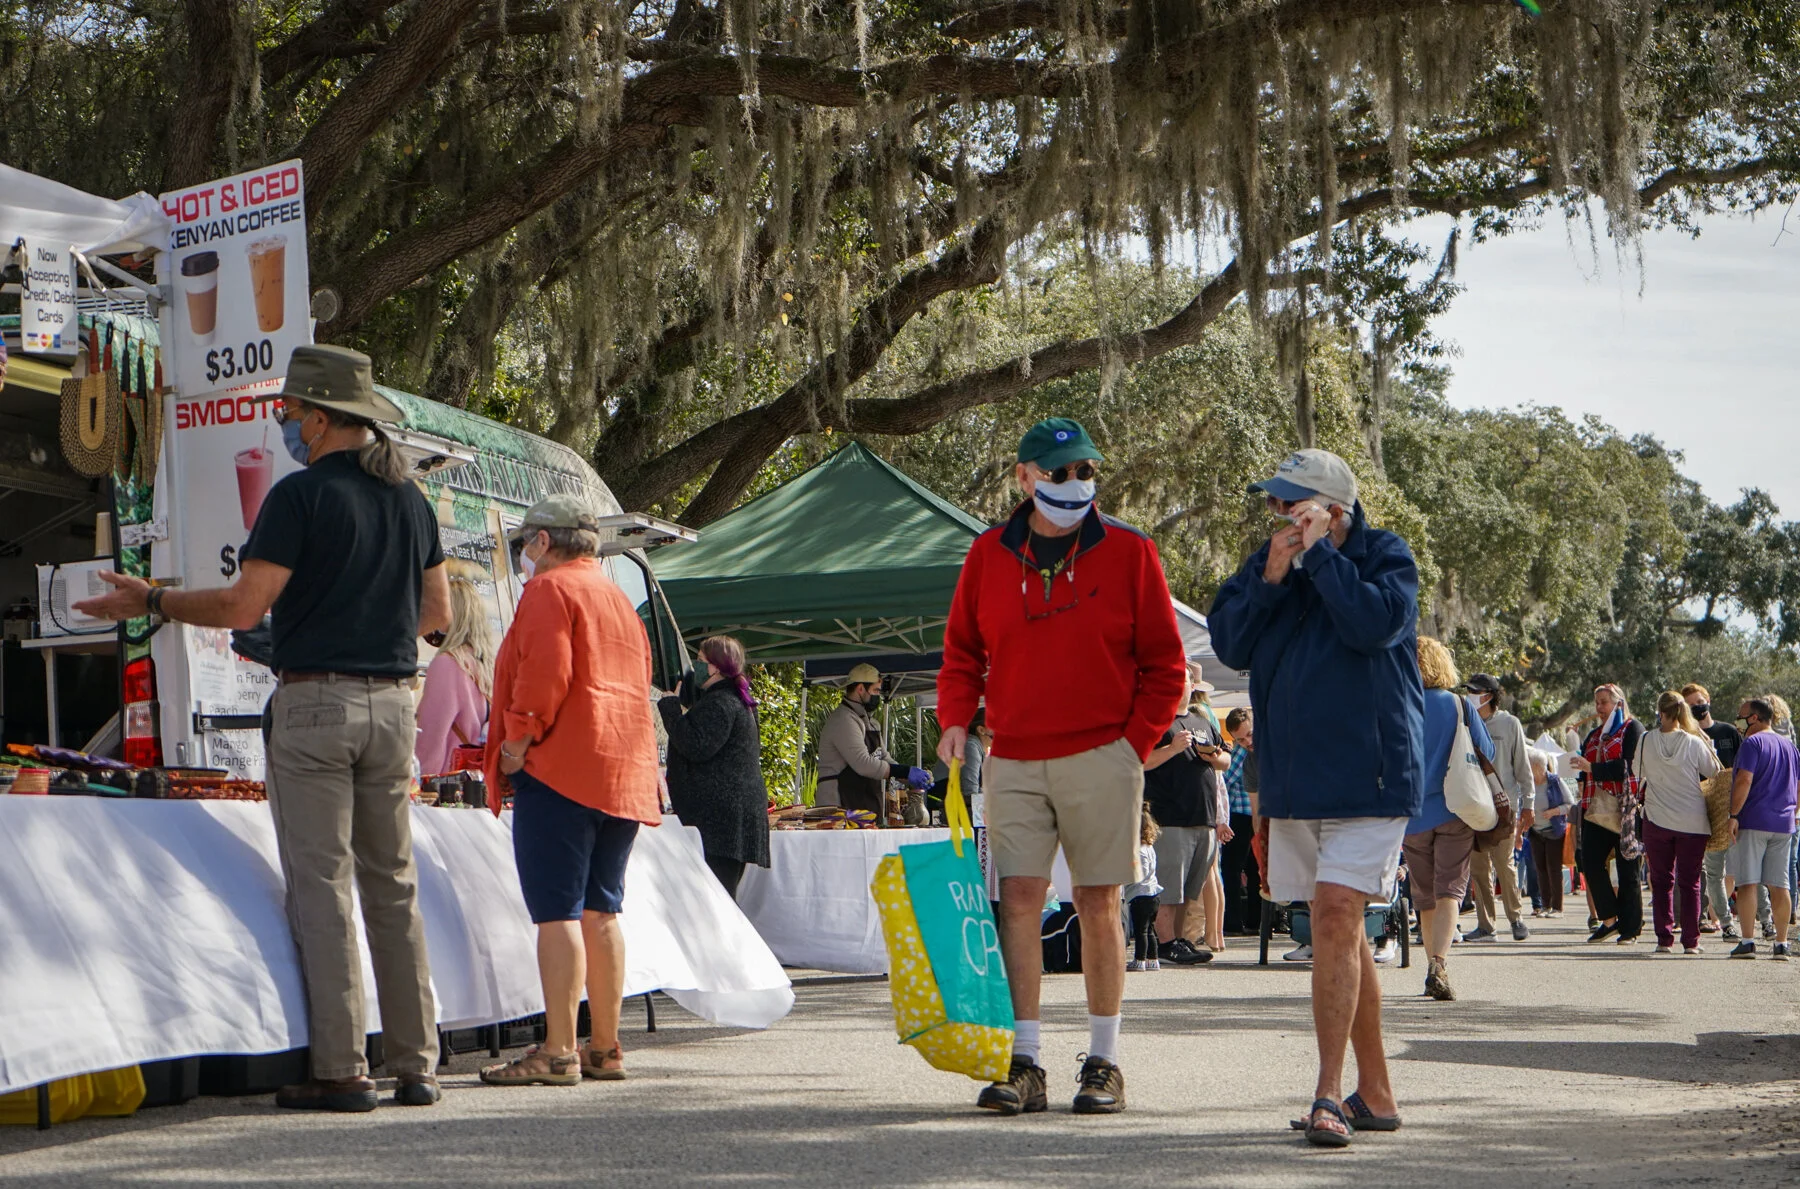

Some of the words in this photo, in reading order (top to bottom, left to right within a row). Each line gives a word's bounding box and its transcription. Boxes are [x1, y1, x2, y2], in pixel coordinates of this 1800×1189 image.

[162, 188, 215, 224] HOT
[220, 183, 239, 213] &
[242, 166, 299, 207] ICED
[237, 200, 301, 233] COFFEE
[37, 247, 58, 262] Now
[27, 267, 70, 287] Accepting
[23, 286, 77, 305] Credit/Debit
[37, 308, 64, 324] Cards
[206, 338, 273, 385] $3.00
[245, 672, 269, 684] Fruit
[208, 703, 238, 715] Peach
[212, 738, 249, 753] Mango
[212, 754, 252, 770] Orange
[962, 916, 1008, 979] CR
